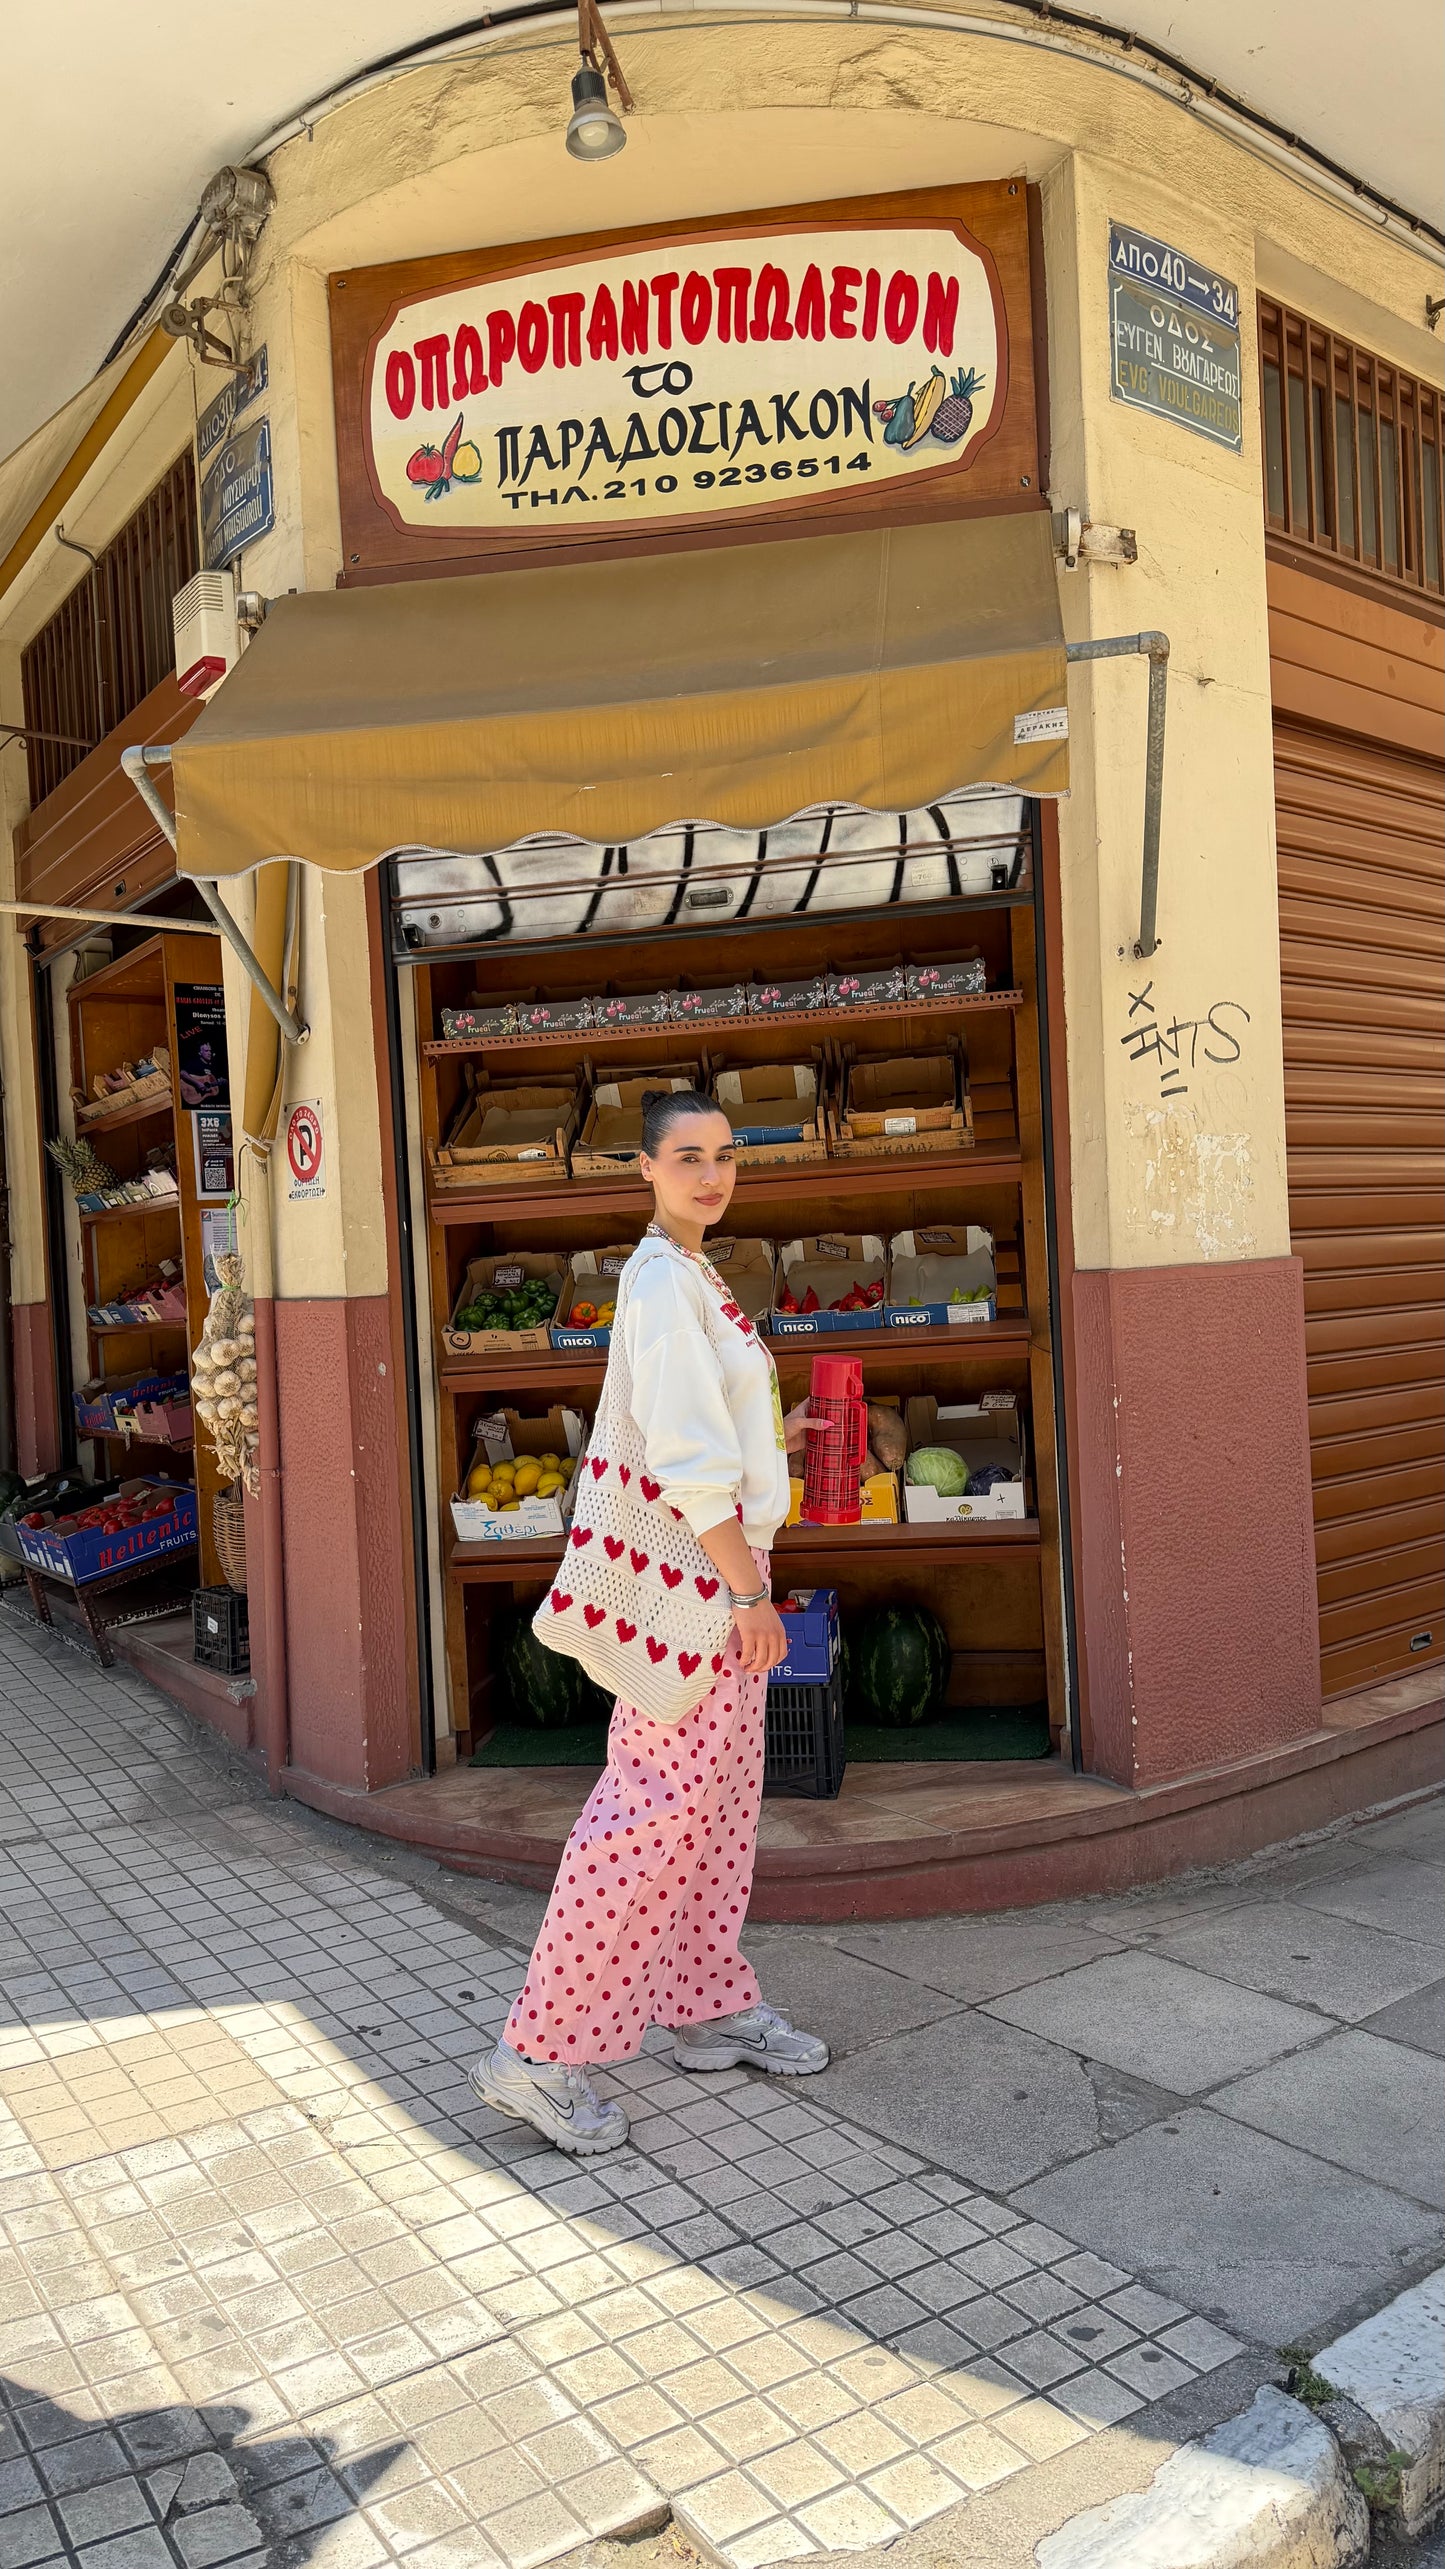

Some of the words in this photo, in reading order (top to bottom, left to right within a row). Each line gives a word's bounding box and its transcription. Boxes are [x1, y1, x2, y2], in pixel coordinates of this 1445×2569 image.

[1212, 280, 1236, 321] 34
[384, 262, 960, 421] ΟΠΩΡΟΠΑΝΤΟΠΩΛΕΙΟΝ
[1150, 304, 1214, 353] ΟΔΟΣ
[1159, 374, 1239, 434] VOULGAREOS
[494, 378, 873, 489] ΠΑΡΑΔΟΣΙΑΚΟΝ
[693, 452, 873, 489] 9236514
[562, 1337, 592, 1346] nico
[783, 1321, 814, 1333] nico
[895, 1313, 928, 1325] nico
[98, 1510, 192, 1570] Hellenic
